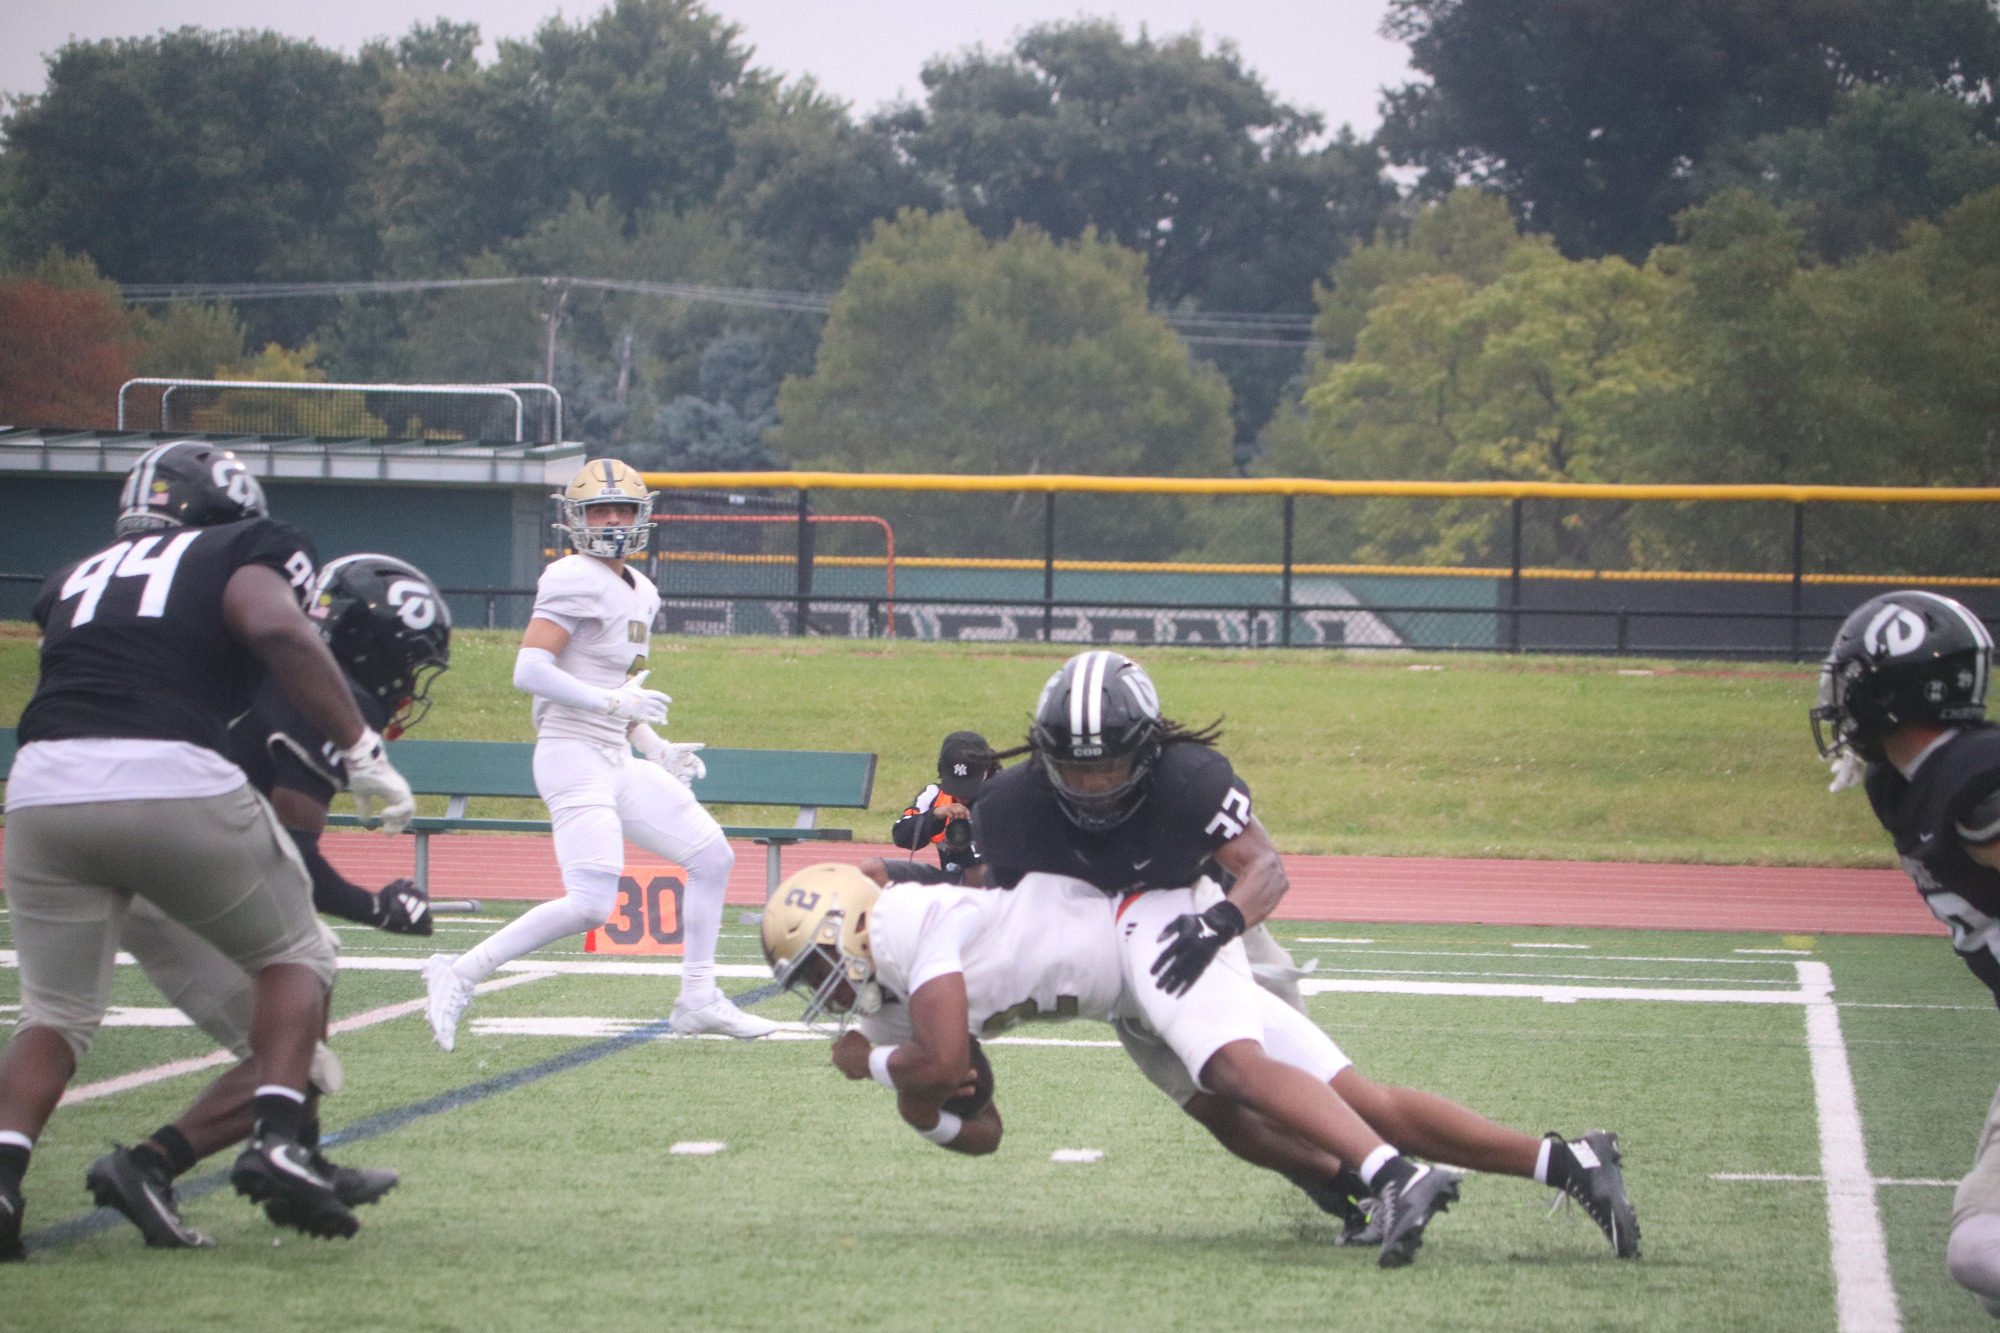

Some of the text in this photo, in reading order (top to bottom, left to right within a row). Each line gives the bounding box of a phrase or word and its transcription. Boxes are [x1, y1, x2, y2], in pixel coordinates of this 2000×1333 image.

[60, 530, 203, 628] 94
[954, 763, 968, 776] NY
[605, 876, 684, 945] 30
[784, 889, 821, 911] 2
